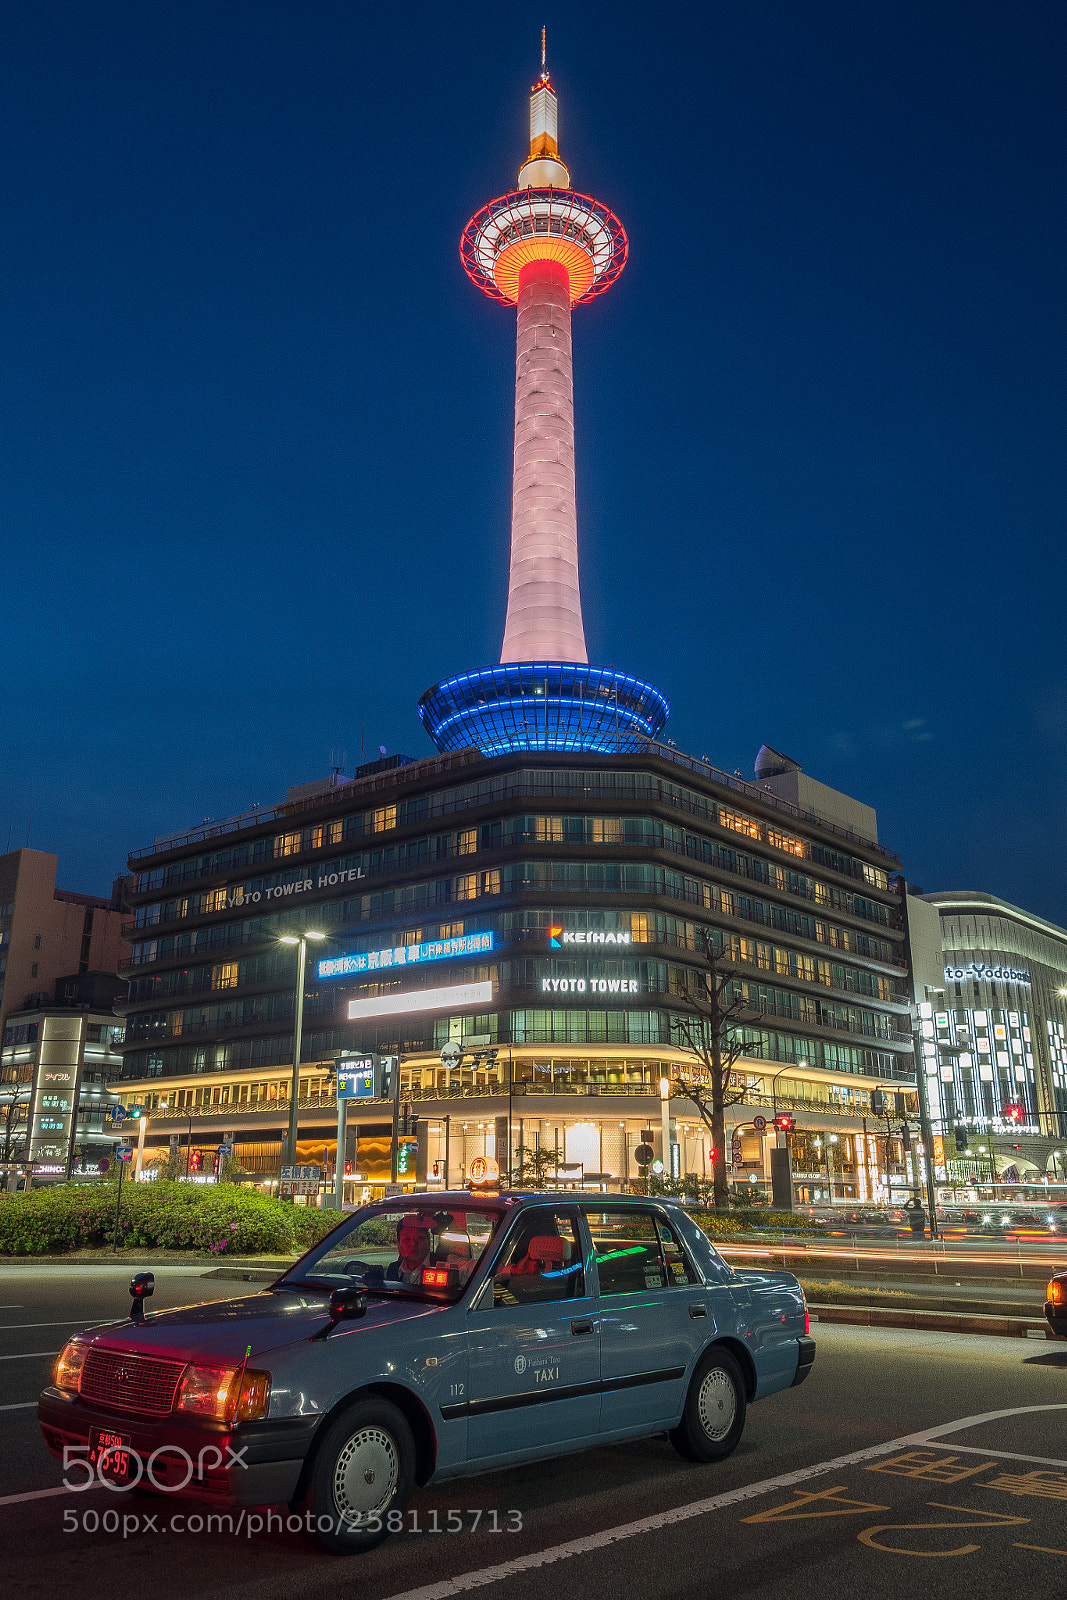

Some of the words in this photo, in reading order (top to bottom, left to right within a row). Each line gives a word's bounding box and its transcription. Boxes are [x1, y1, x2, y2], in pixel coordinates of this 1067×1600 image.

[220, 891, 261, 910] KYOTO
[265, 879, 313, 899] TOWER
[318, 867, 366, 888] HOTEL
[563, 931, 630, 944] KEIHAN
[542, 978, 586, 992] KYOTO
[590, 979, 638, 993] TOWER
[534, 1366, 559, 1383] TAXI
[450, 1383, 464, 1396] 112
